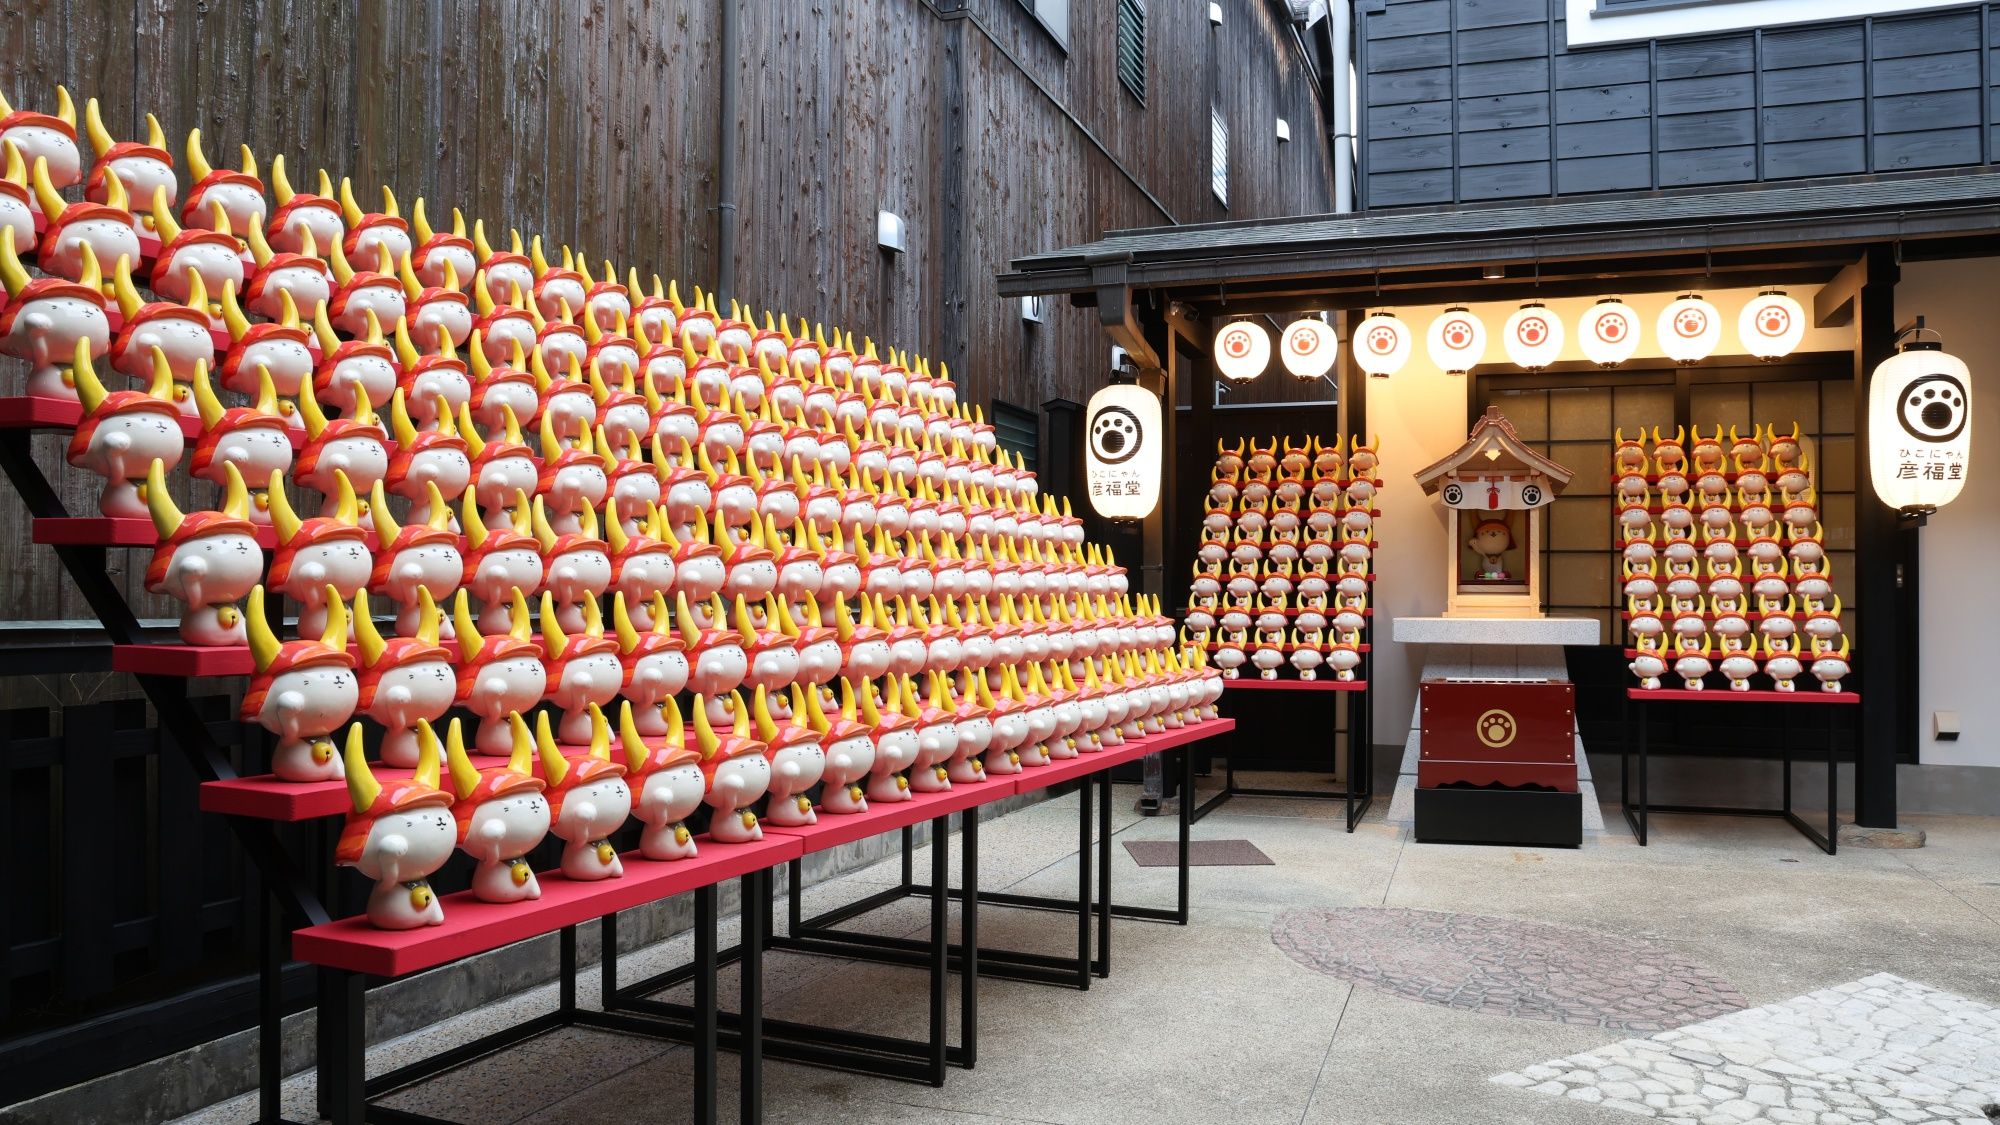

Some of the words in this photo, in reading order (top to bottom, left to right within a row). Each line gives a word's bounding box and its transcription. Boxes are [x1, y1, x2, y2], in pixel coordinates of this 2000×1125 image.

[1899, 448, 1963, 459] ひこにゃん
[1896, 460, 1962, 480] 彦福堂
[1092, 480, 1140, 496] 彦福堂
